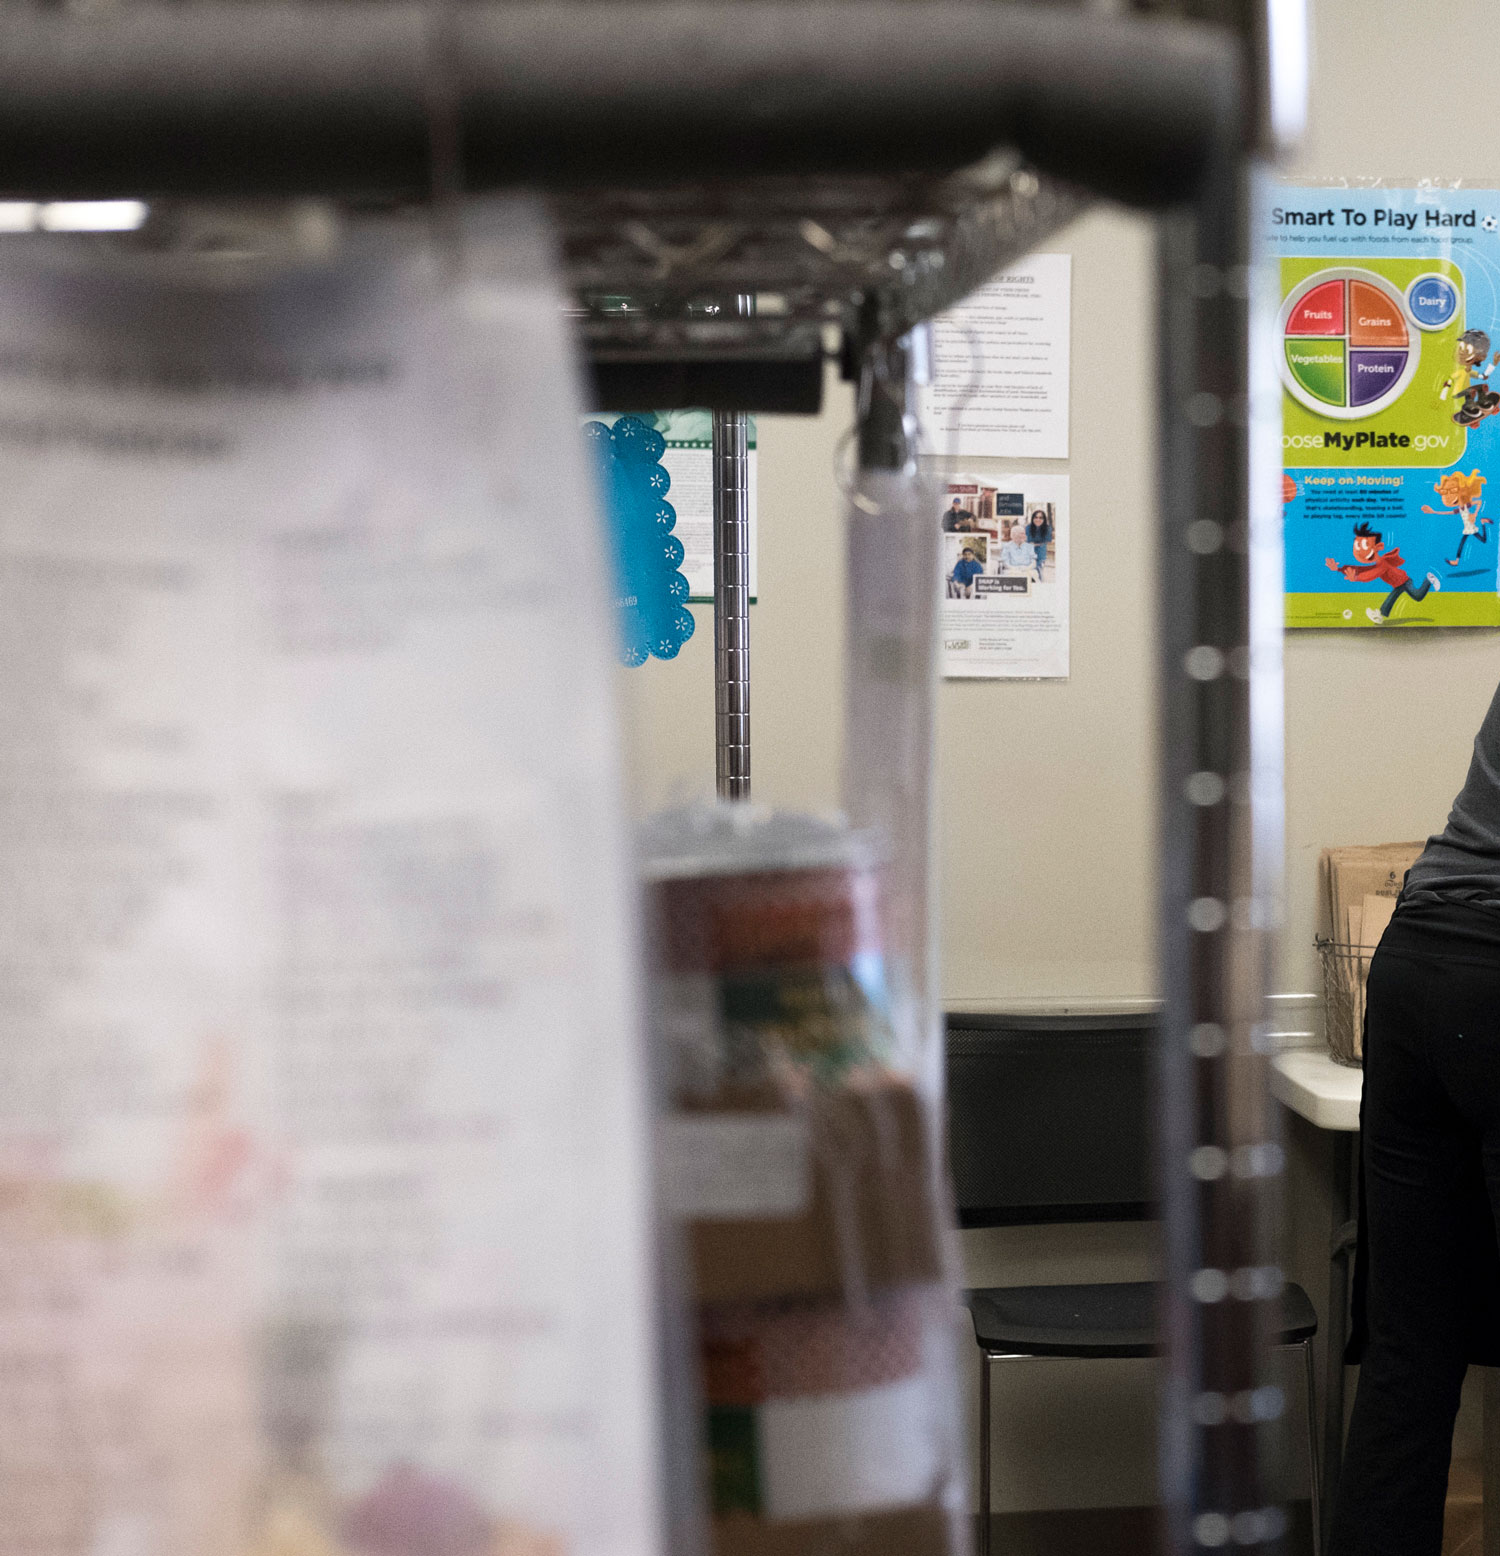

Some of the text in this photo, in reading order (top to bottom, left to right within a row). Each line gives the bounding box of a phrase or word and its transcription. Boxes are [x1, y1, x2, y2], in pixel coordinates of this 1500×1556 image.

[1272, 208, 1476, 230] Smart To Play Hard
[1419, 297, 1446, 307] Dairy
[1304, 310, 1332, 319] Fruits
[1359, 317, 1391, 326] Grains
[1291, 355, 1343, 365] Vegetables
[1357, 364, 1394, 373] Protein
[1279, 431, 1449, 451] ooseMyPlate.gov
[1304, 476, 1404, 487] Keep on Moving!
